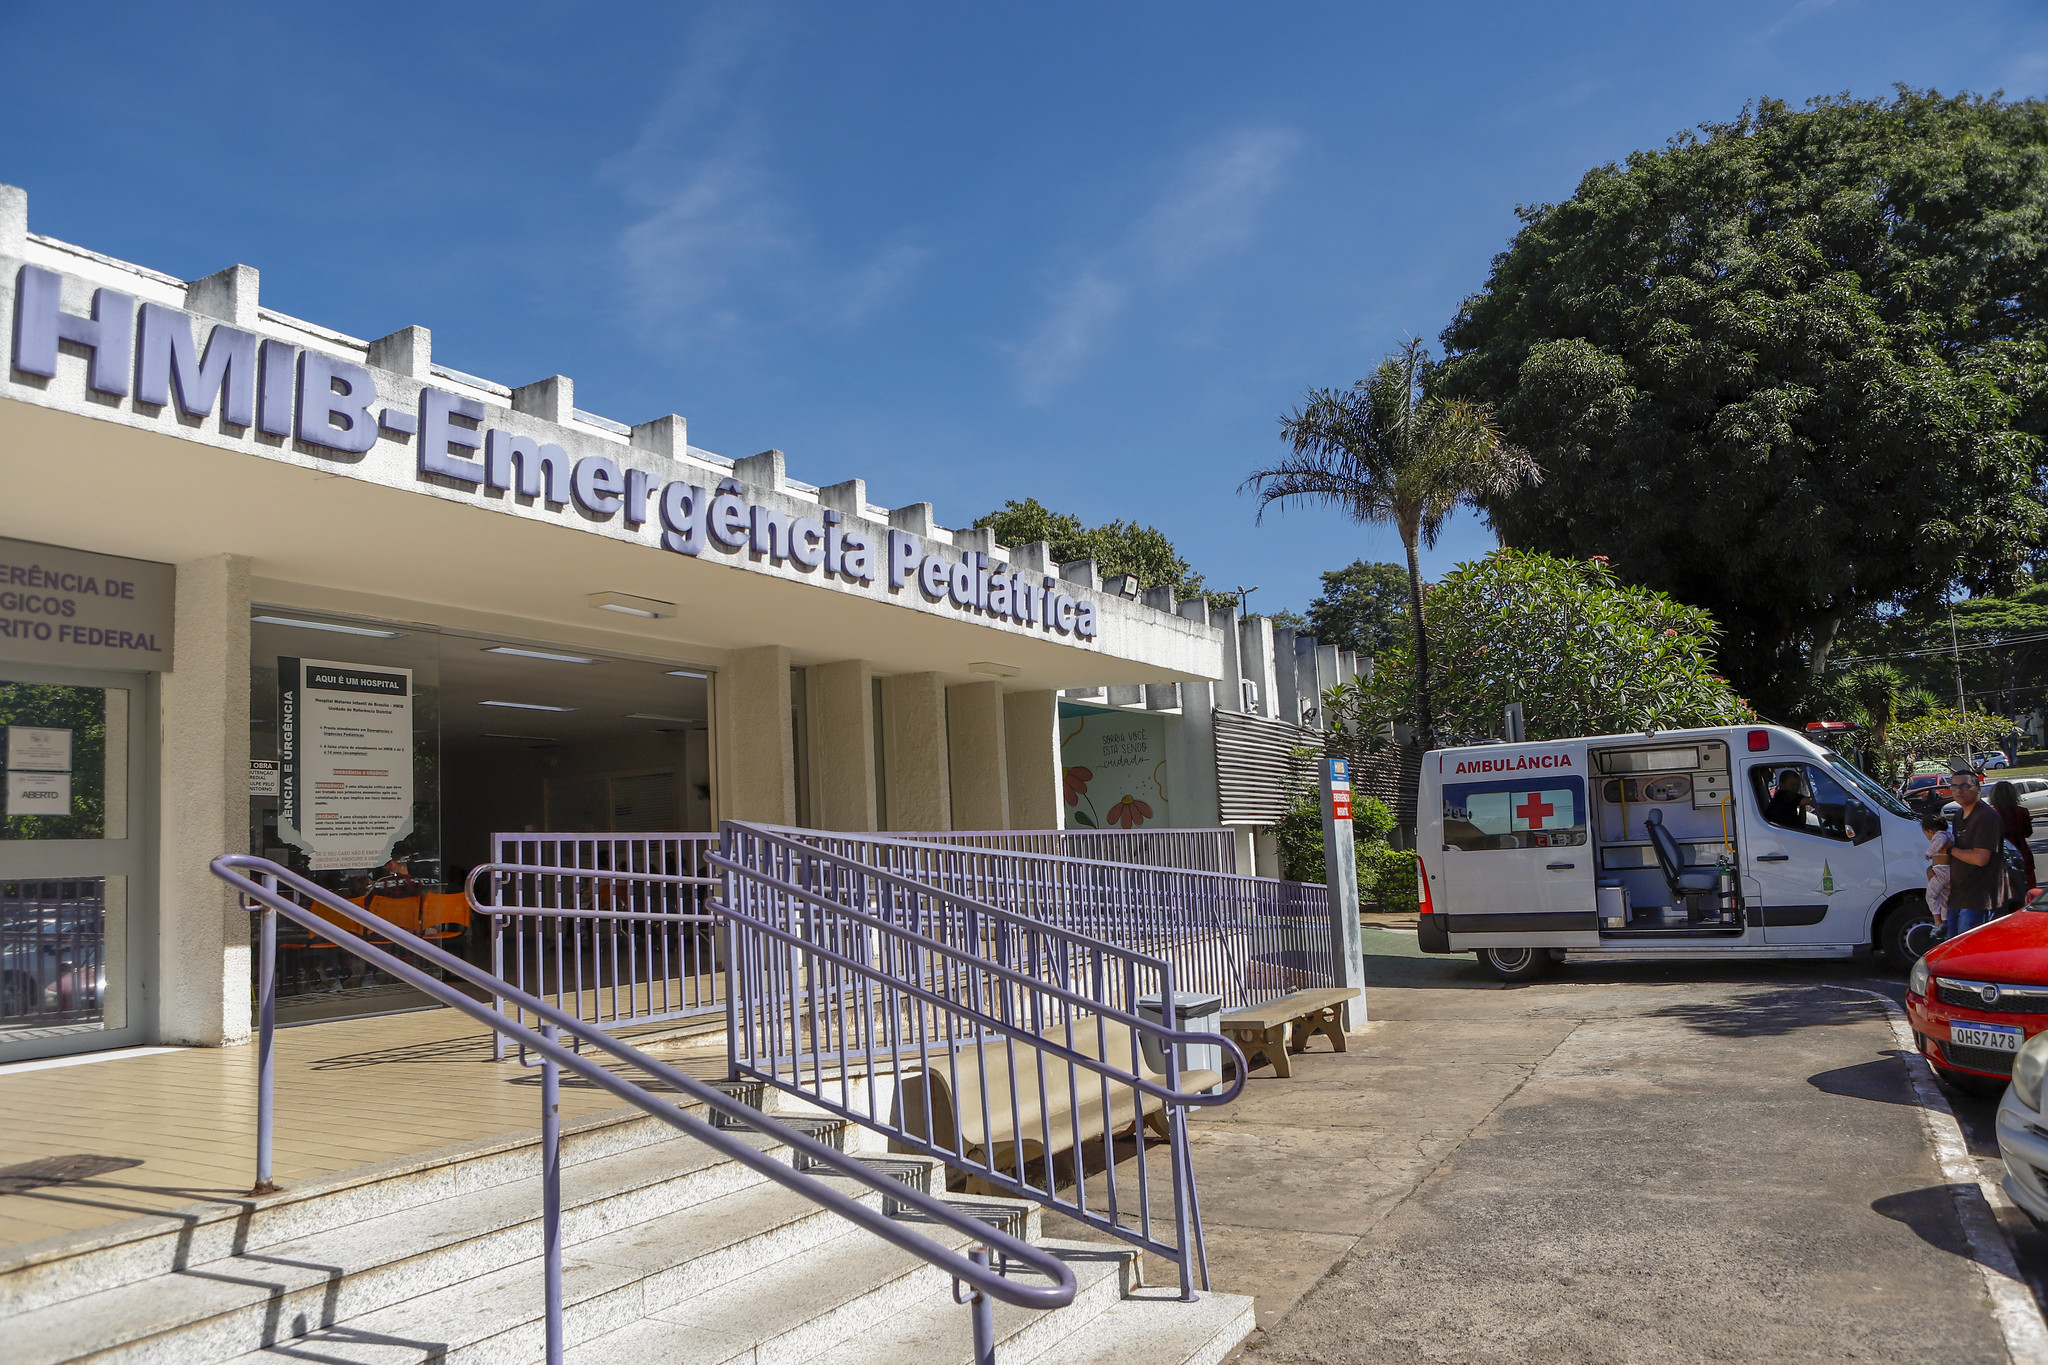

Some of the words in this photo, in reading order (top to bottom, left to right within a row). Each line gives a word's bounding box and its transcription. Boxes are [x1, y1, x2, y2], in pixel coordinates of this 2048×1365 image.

[105, 579, 135, 600] DE
[889, 529, 1098, 639] Pediátrica
[0, 592, 76, 617] GICOS
[0, 618, 52, 641] RITO
[59, 624, 162, 652] FEDERAL
[315, 674, 336, 684] AQUI
[338, 675, 344, 684] É
[345, 677, 358, 686] UM
[361, 678, 399, 689] HOSPITAL
[282, 690, 293, 760] URGÊNCIA
[1102, 733, 1125, 745] SORRIA
[1128, 728, 1148, 741] VOCÊ
[1121, 742, 1147, 754] SENDO
[283, 764, 293, 773] E
[1455, 754, 1572, 775] AMBULÂNCIA
[22, 791, 58, 799] ABERTO
[1983, 989, 1994, 998] FIAT
[1957, 1029, 2015, 1050] OHS7A78
